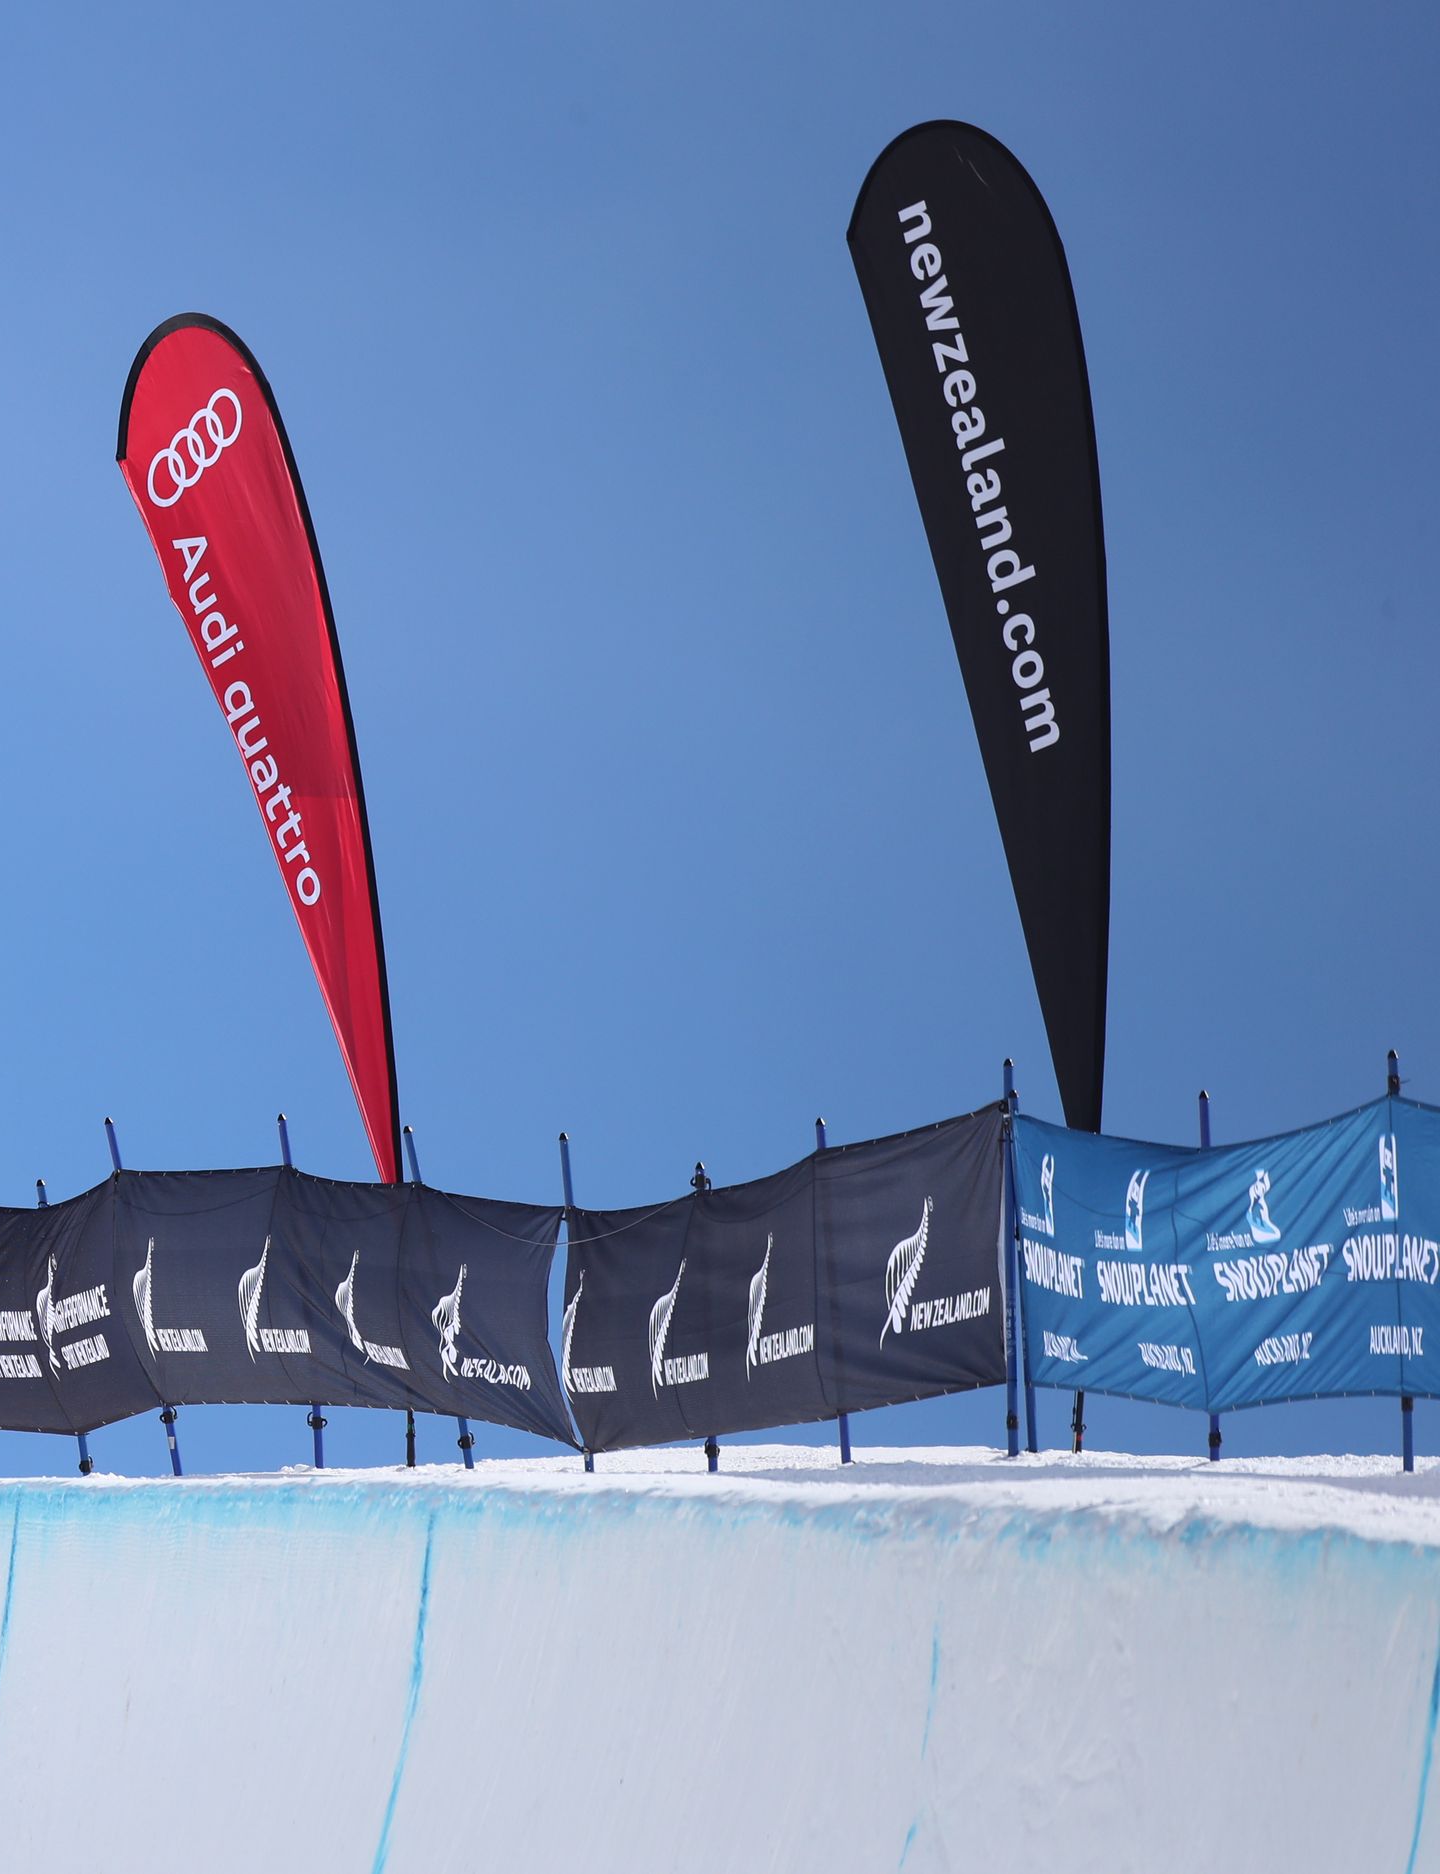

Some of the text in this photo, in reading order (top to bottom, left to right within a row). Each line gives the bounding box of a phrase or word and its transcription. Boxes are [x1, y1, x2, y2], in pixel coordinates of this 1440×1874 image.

[898, 200, 1060, 753] newzealand.com
[172, 536, 321, 906] Audi quattro
[1023, 1238, 1084, 1299] SNOWPLANET
[1096, 1260, 1196, 1307] SNOWPLANET
[1213, 1243, 1330, 1302] SNOWPLANET
[1342, 1233, 1440, 1285] SNOWPLANET
[1370, 1326, 1423, 1360] AUCKLAND, NZ
